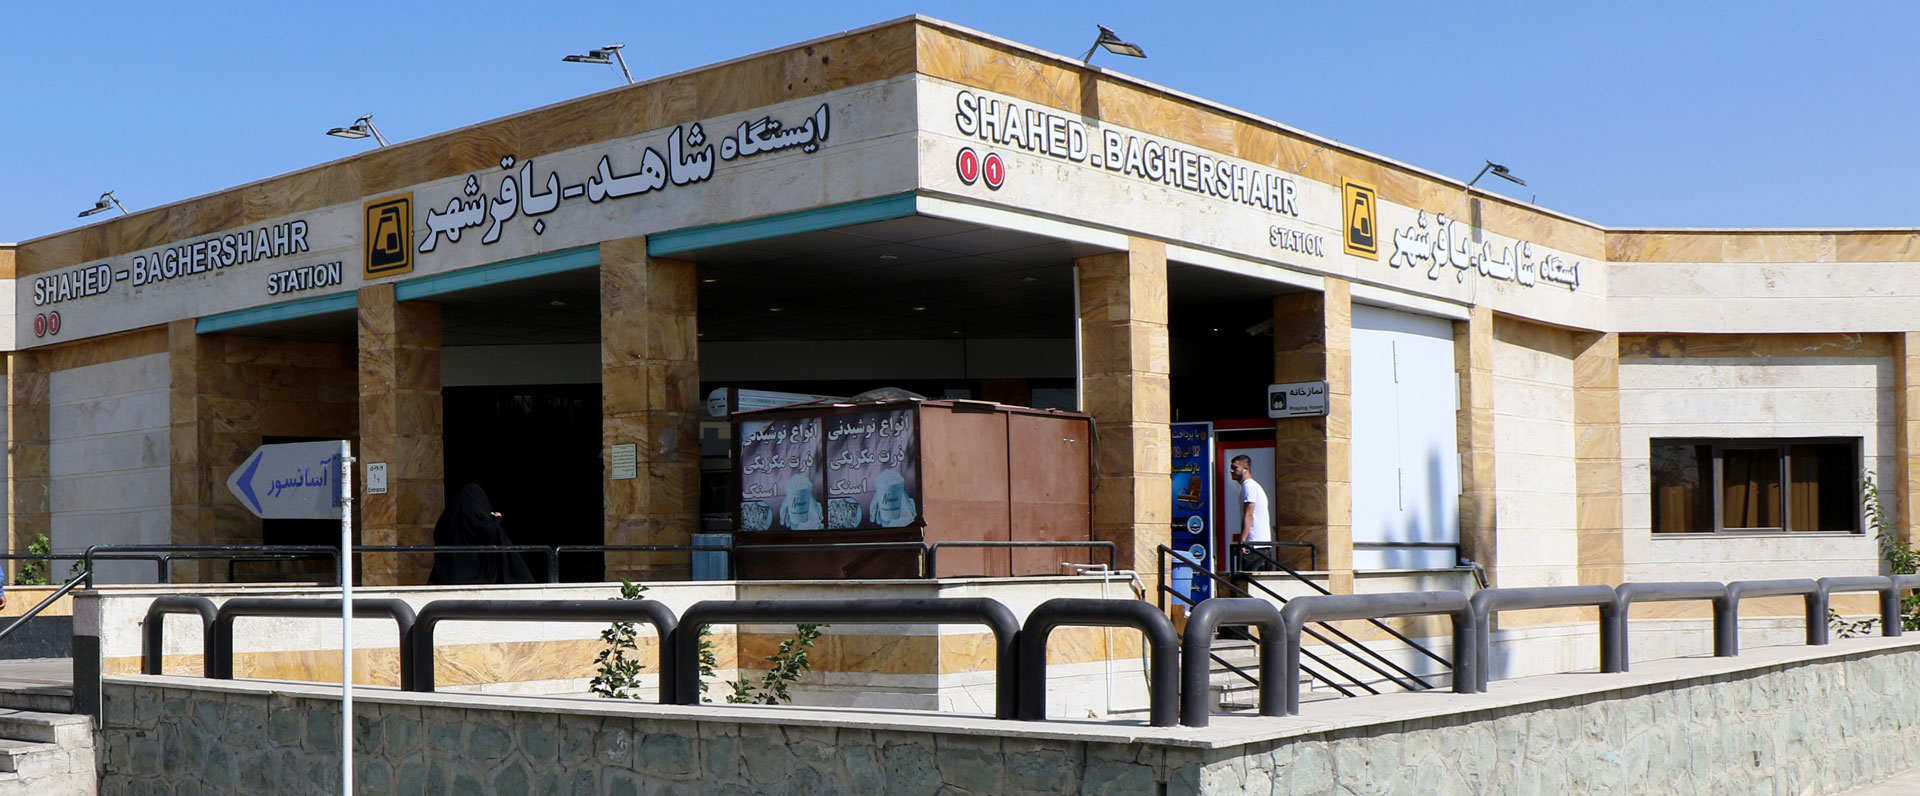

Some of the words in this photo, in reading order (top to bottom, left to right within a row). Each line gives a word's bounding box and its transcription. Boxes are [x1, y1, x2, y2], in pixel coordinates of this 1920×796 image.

[720, 103, 830, 161] ایستگاه
[1269, 224, 1325, 258] STATION
[33, 262, 111, 306] SHAHED
[132, 220, 308, 286] BAGHERSHAHR
[1540, 254, 1580, 291] ایستگاه
[266, 262, 342, 296] STATION
[789, 422, 818, 444] انواع
[828, 418, 877, 441] نوشیدنی
[879, 415, 909, 438] انواع
[743, 454, 786, 475] مکزیکی
[788, 450, 814, 473] ذرت
[830, 448, 875, 471] مکزیکی
[878, 445, 905, 468] ذرت
[266, 457, 332, 499] آسانسور
[829, 478, 868, 495] اسنک
[742, 482, 778, 499] اسنک
